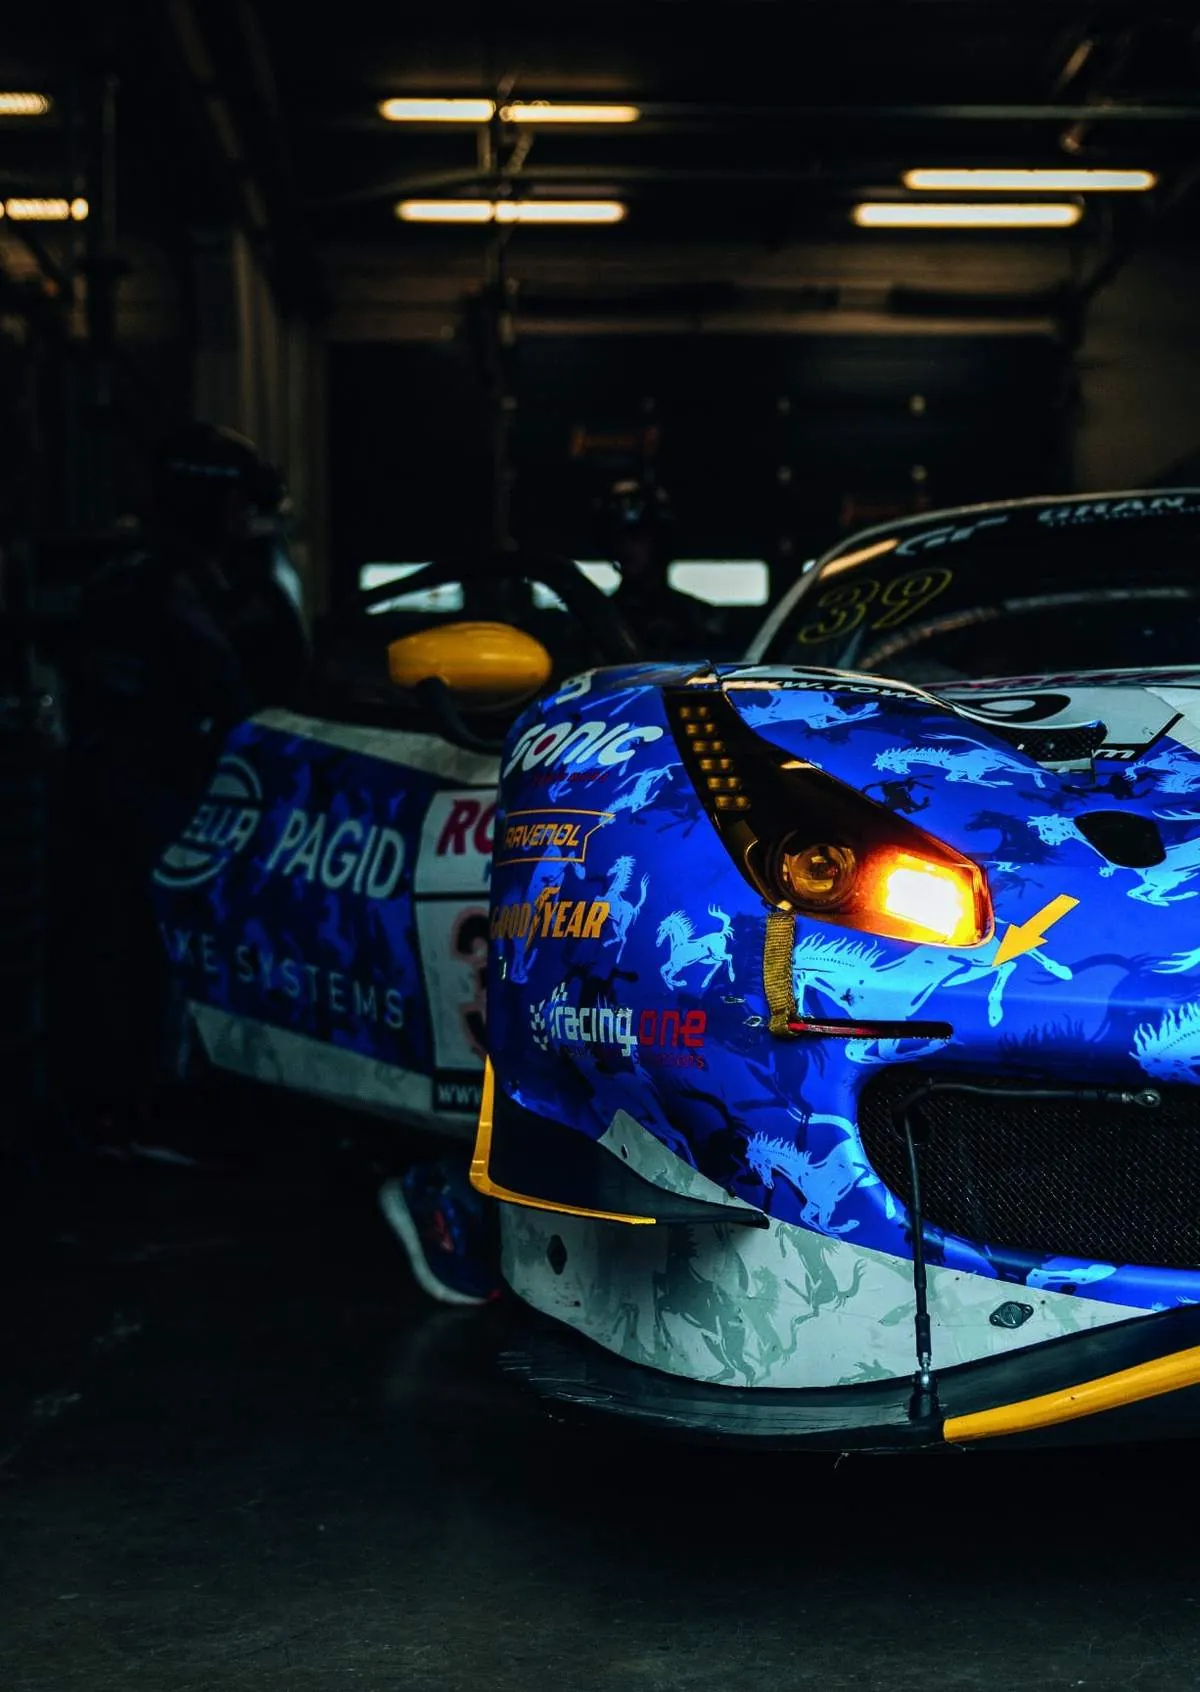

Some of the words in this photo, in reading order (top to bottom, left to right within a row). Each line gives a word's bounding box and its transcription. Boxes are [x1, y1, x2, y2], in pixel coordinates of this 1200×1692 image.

[798, 567, 953, 644] 39
[181, 803, 262, 855] ELLA
[263, 807, 406, 899] PAGID
[506, 823, 580, 847] RAVENOL
[234, 942, 405, 1030] SYSTEMS
[553, 1005, 638, 1057] racing
[639, 1008, 708, 1048] one
